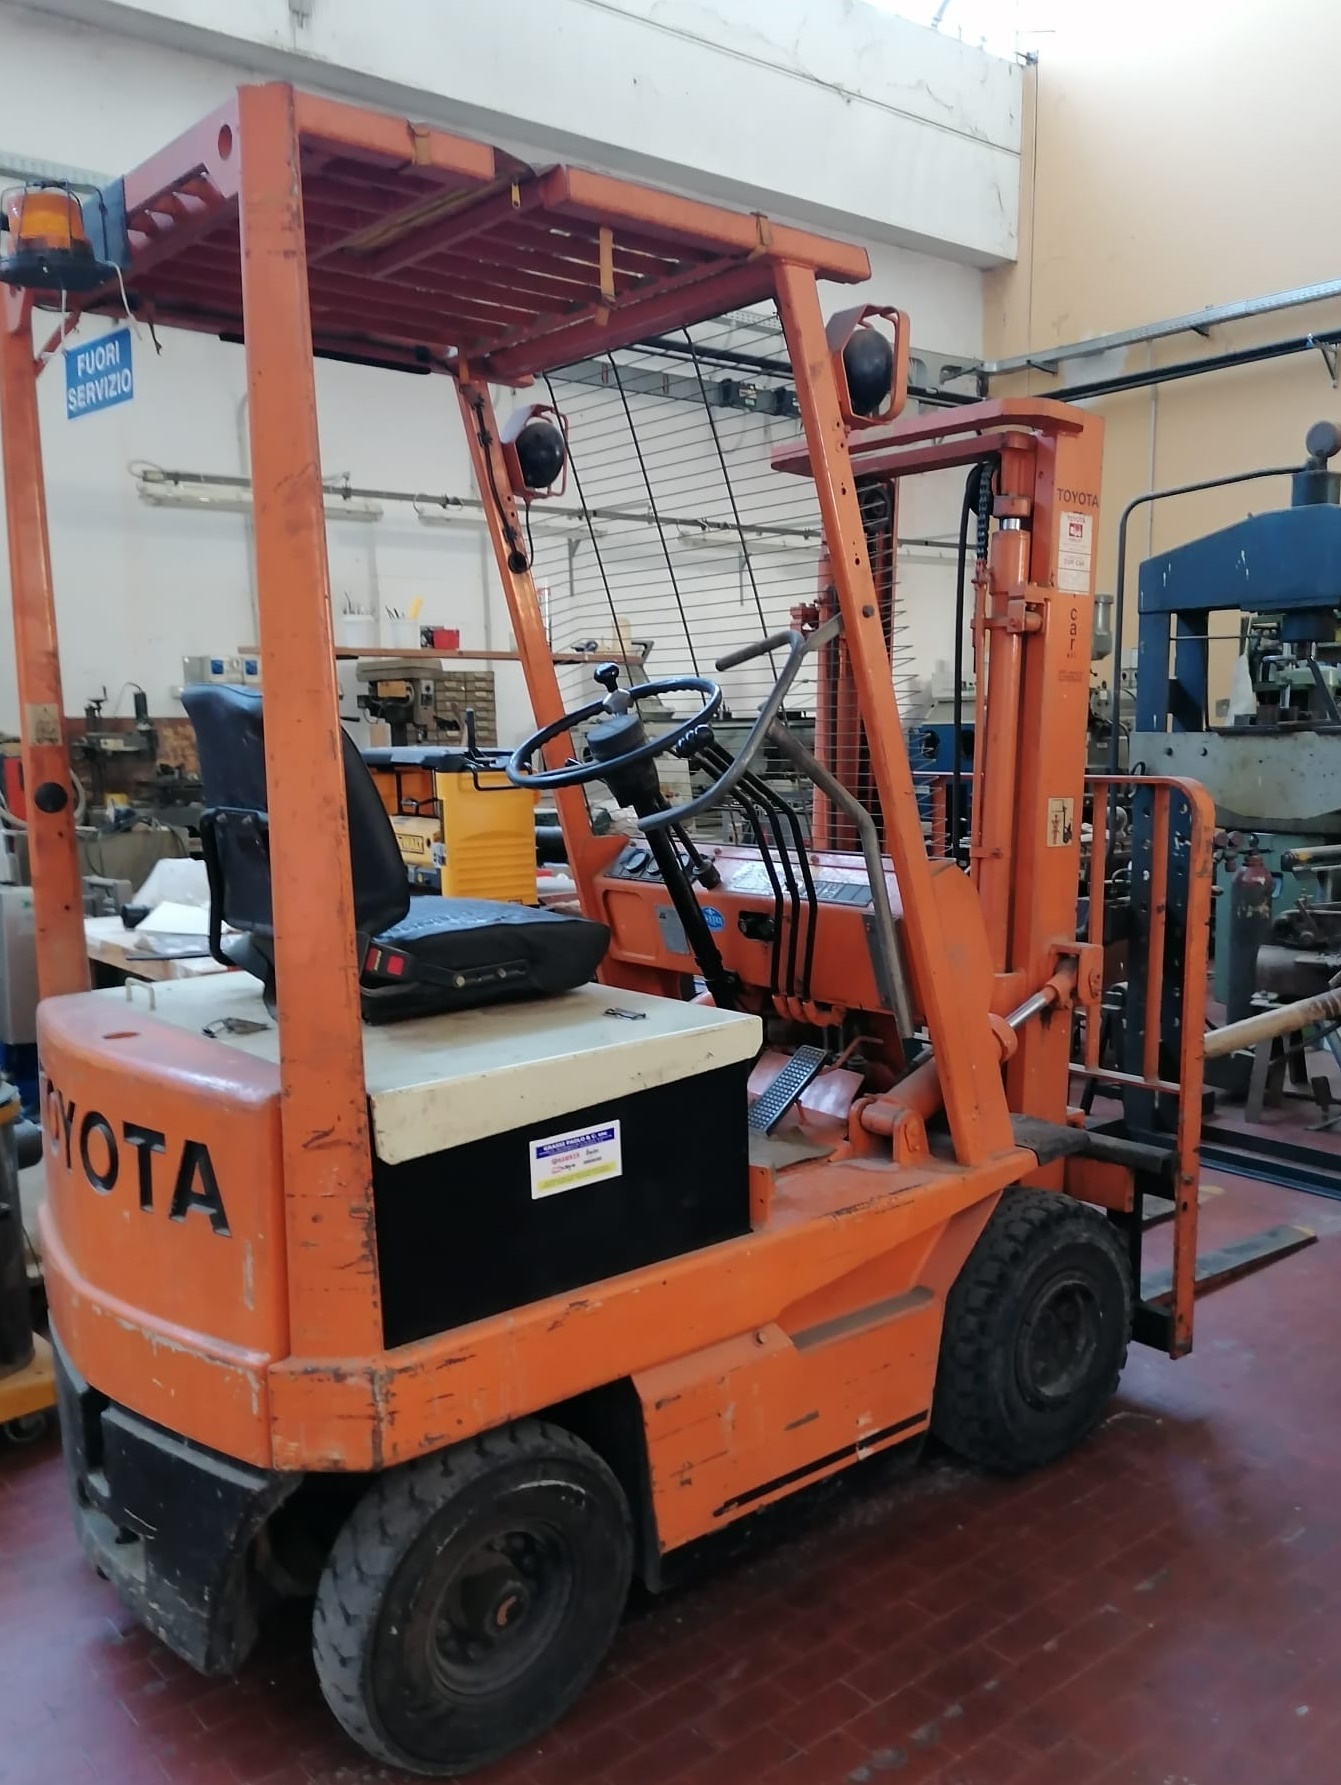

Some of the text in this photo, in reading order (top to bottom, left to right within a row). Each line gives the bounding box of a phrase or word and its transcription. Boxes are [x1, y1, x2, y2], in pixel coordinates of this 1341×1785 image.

[77, 340, 120, 378] FUORI
[68, 368, 132, 412] SERVIZIO
[1057, 487, 1100, 508] TOYOTA
